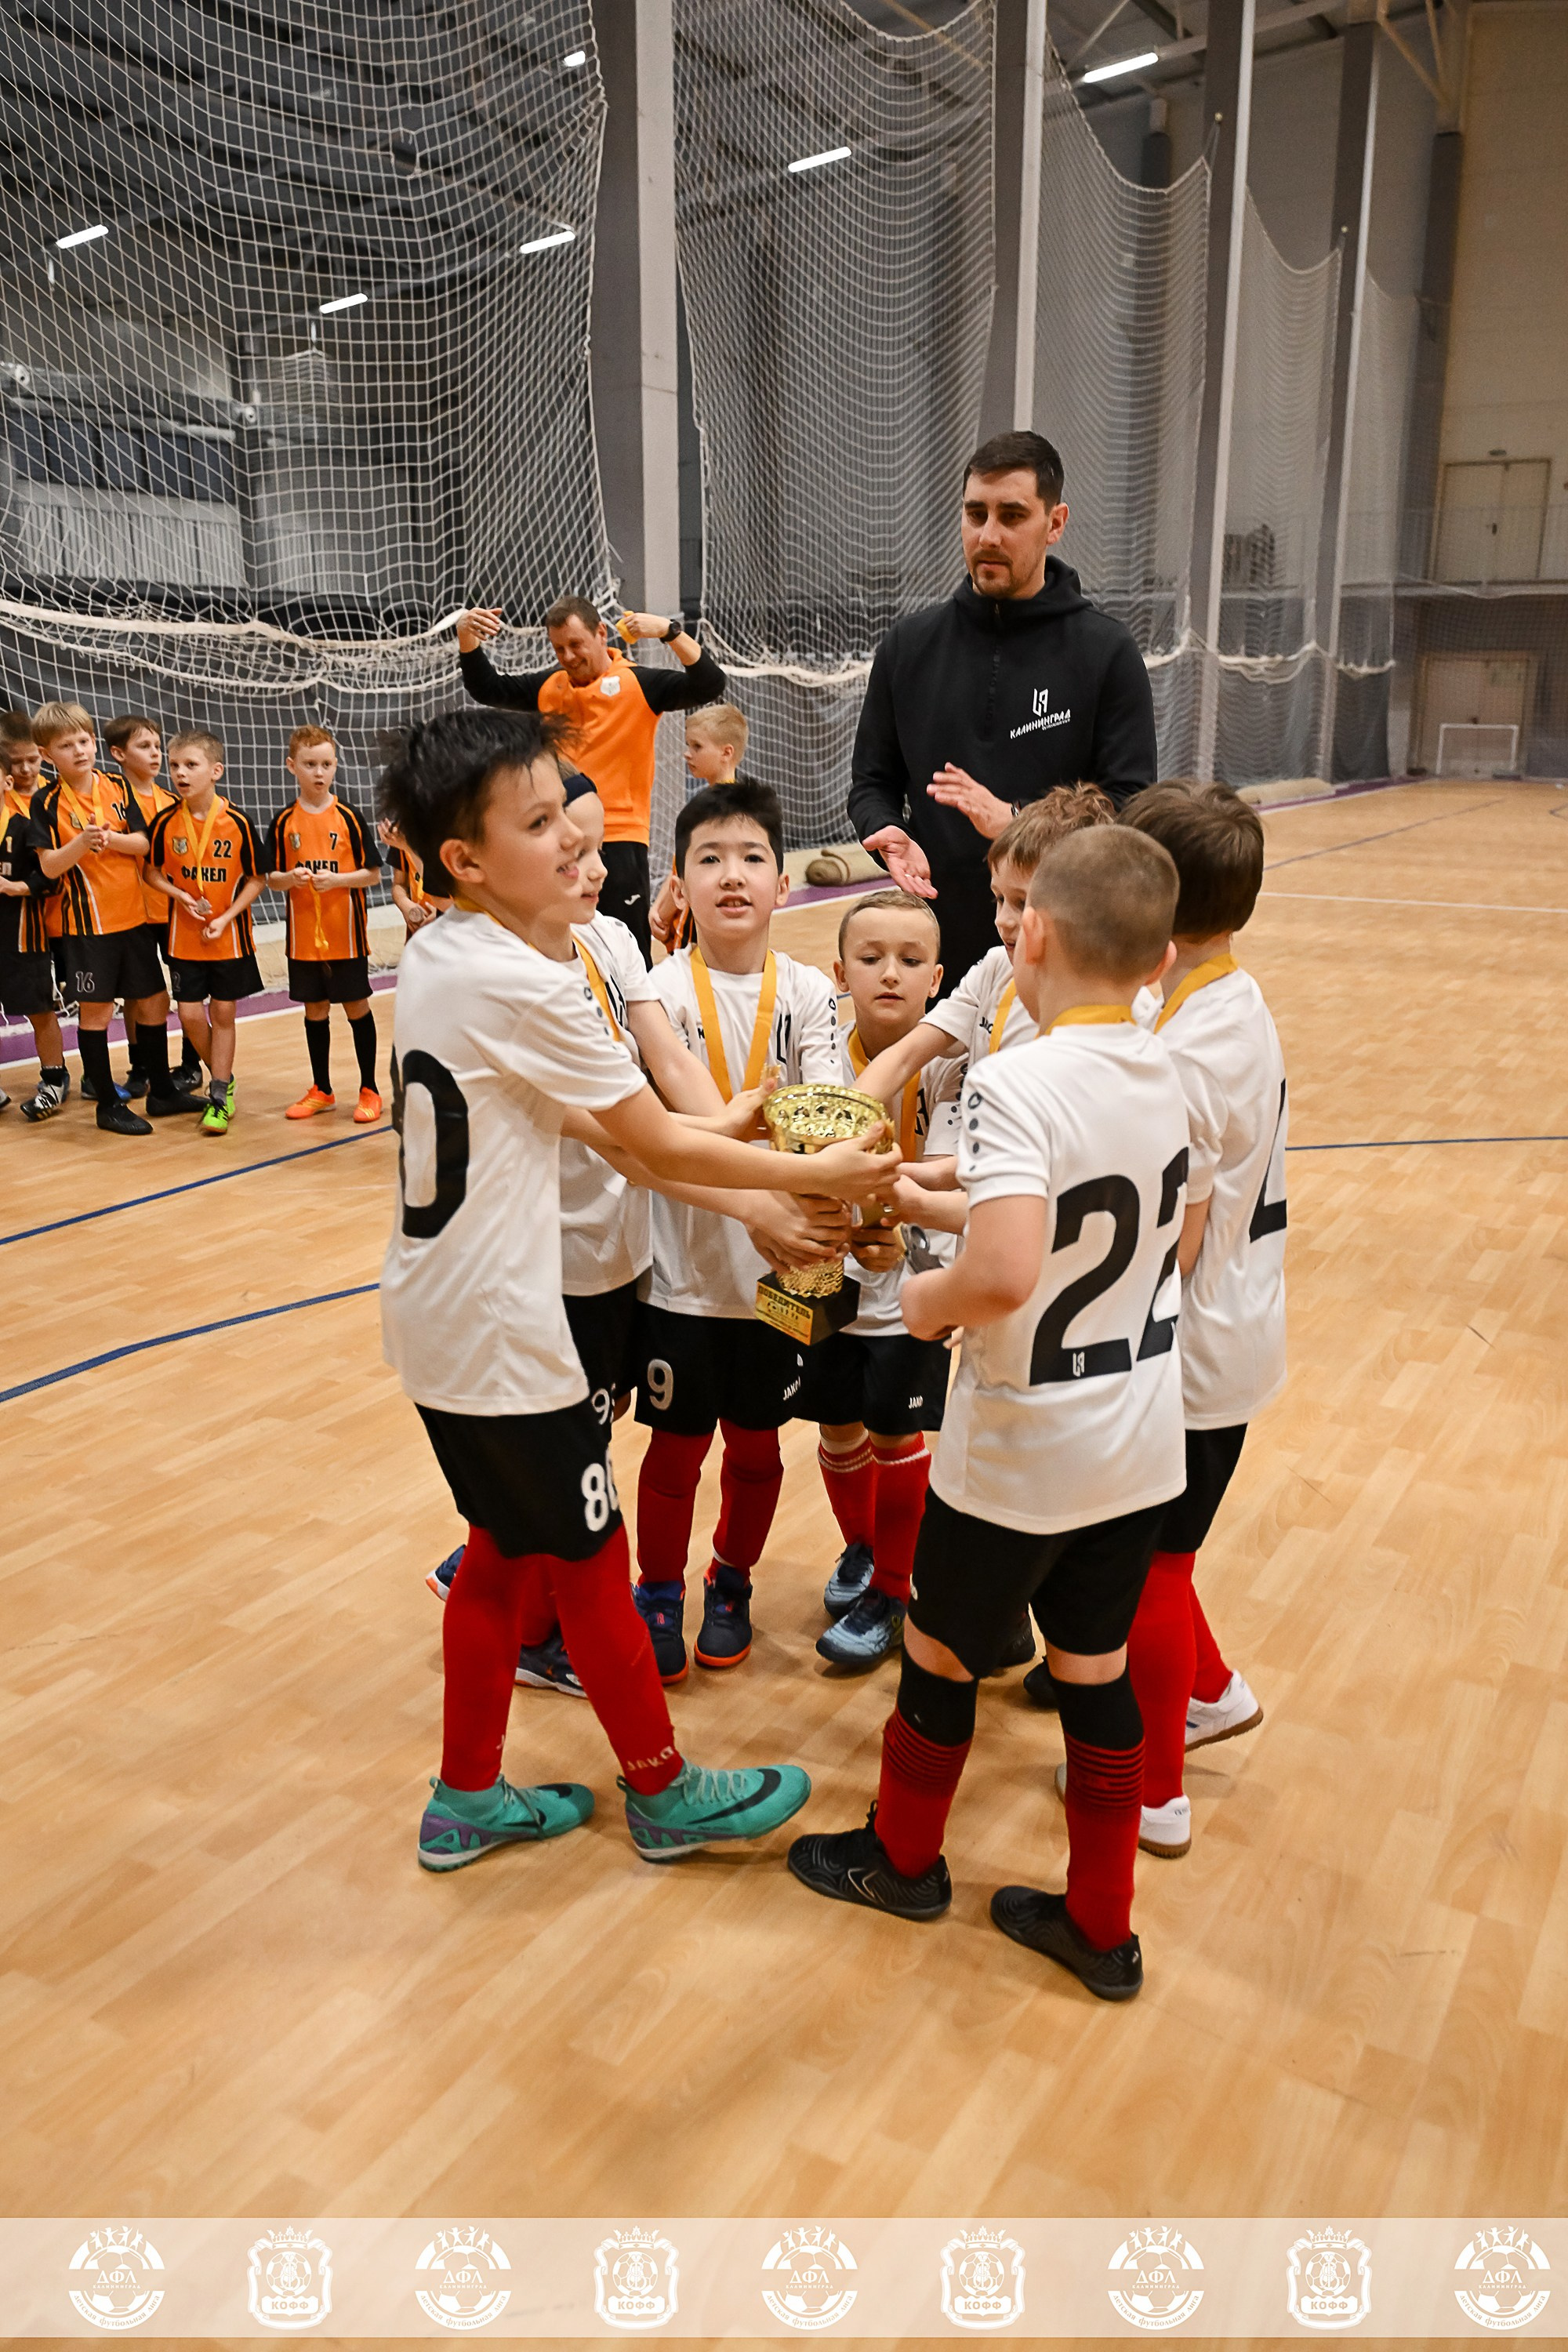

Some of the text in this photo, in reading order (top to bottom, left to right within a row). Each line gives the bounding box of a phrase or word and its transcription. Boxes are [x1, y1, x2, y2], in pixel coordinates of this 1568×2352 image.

[1010, 709, 1071, 739] КАЛИНИНГРАД
[213, 839, 232, 858] 22
[329, 833, 338, 851] 7
[75, 971, 95, 994] 16
[1029, 1146, 1189, 1386] 22
[648, 1359, 674, 1410] 9
